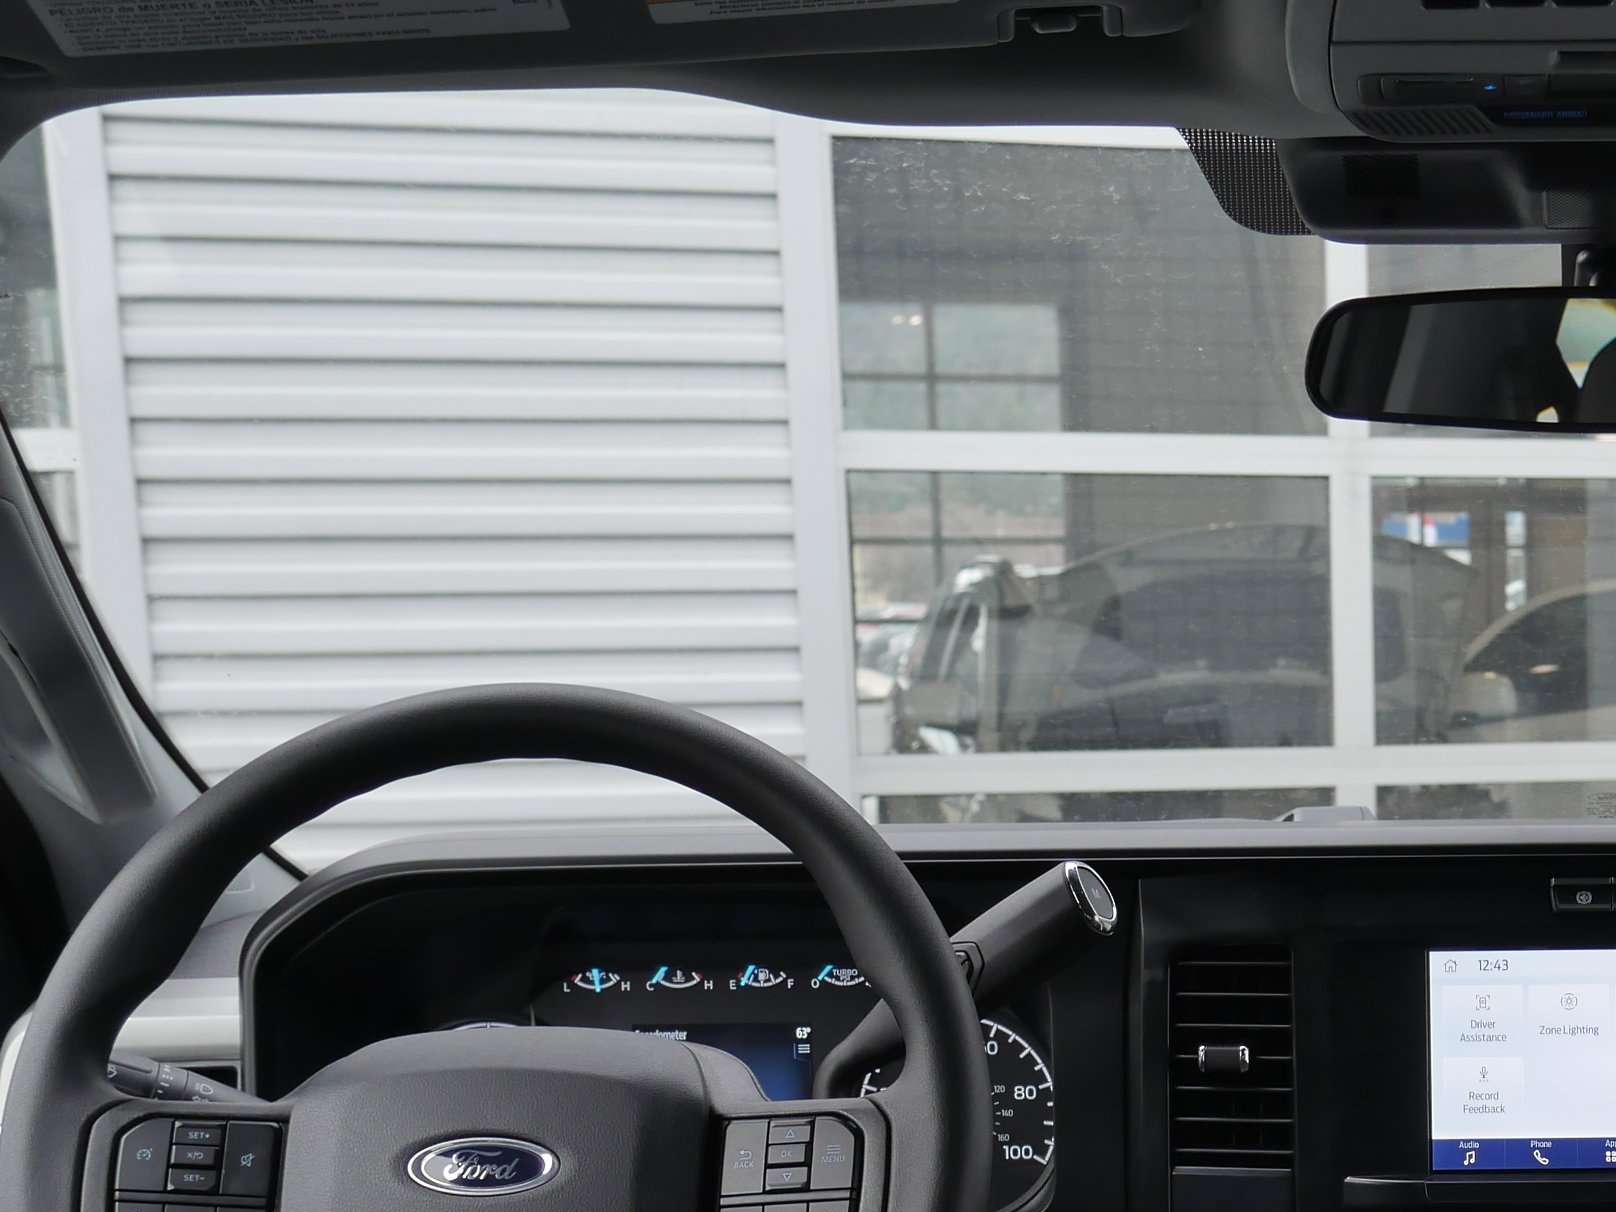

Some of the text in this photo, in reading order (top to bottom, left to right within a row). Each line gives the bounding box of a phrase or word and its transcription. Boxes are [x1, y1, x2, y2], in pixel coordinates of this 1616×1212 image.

[1478, 959, 1509, 971] 12:43
[832, 968, 858, 976] TURBO
[564, 983, 570, 992] L
[621, 981, 630, 992] H
[646, 981, 654, 992] C
[704, 980, 713, 990] H
[729, 979, 736, 990] E
[788, 979, 794, 989] F
[1470, 1019, 1496, 1029] Driver
[1539, 1024, 1599, 1037] Zone Lighting
[1460, 1032, 1507, 1042] Assistance
[994, 1085, 1005, 1093] 120
[1014, 1086, 1037, 1100] 80
[1469, 1091, 1499, 1101] Record
[1001, 1109, 1013, 1117] 140
[1463, 1104, 1505, 1114] Feedback
[998, 1133, 1009, 1142] 160
[1459, 1140, 1479, 1149] Audio
[1530, 1140, 1552, 1148] Phone
[1003, 1145, 1033, 1160] 100
[443, 1150, 519, 1180] Ford
[734, 1161, 754, 1169] BACK
